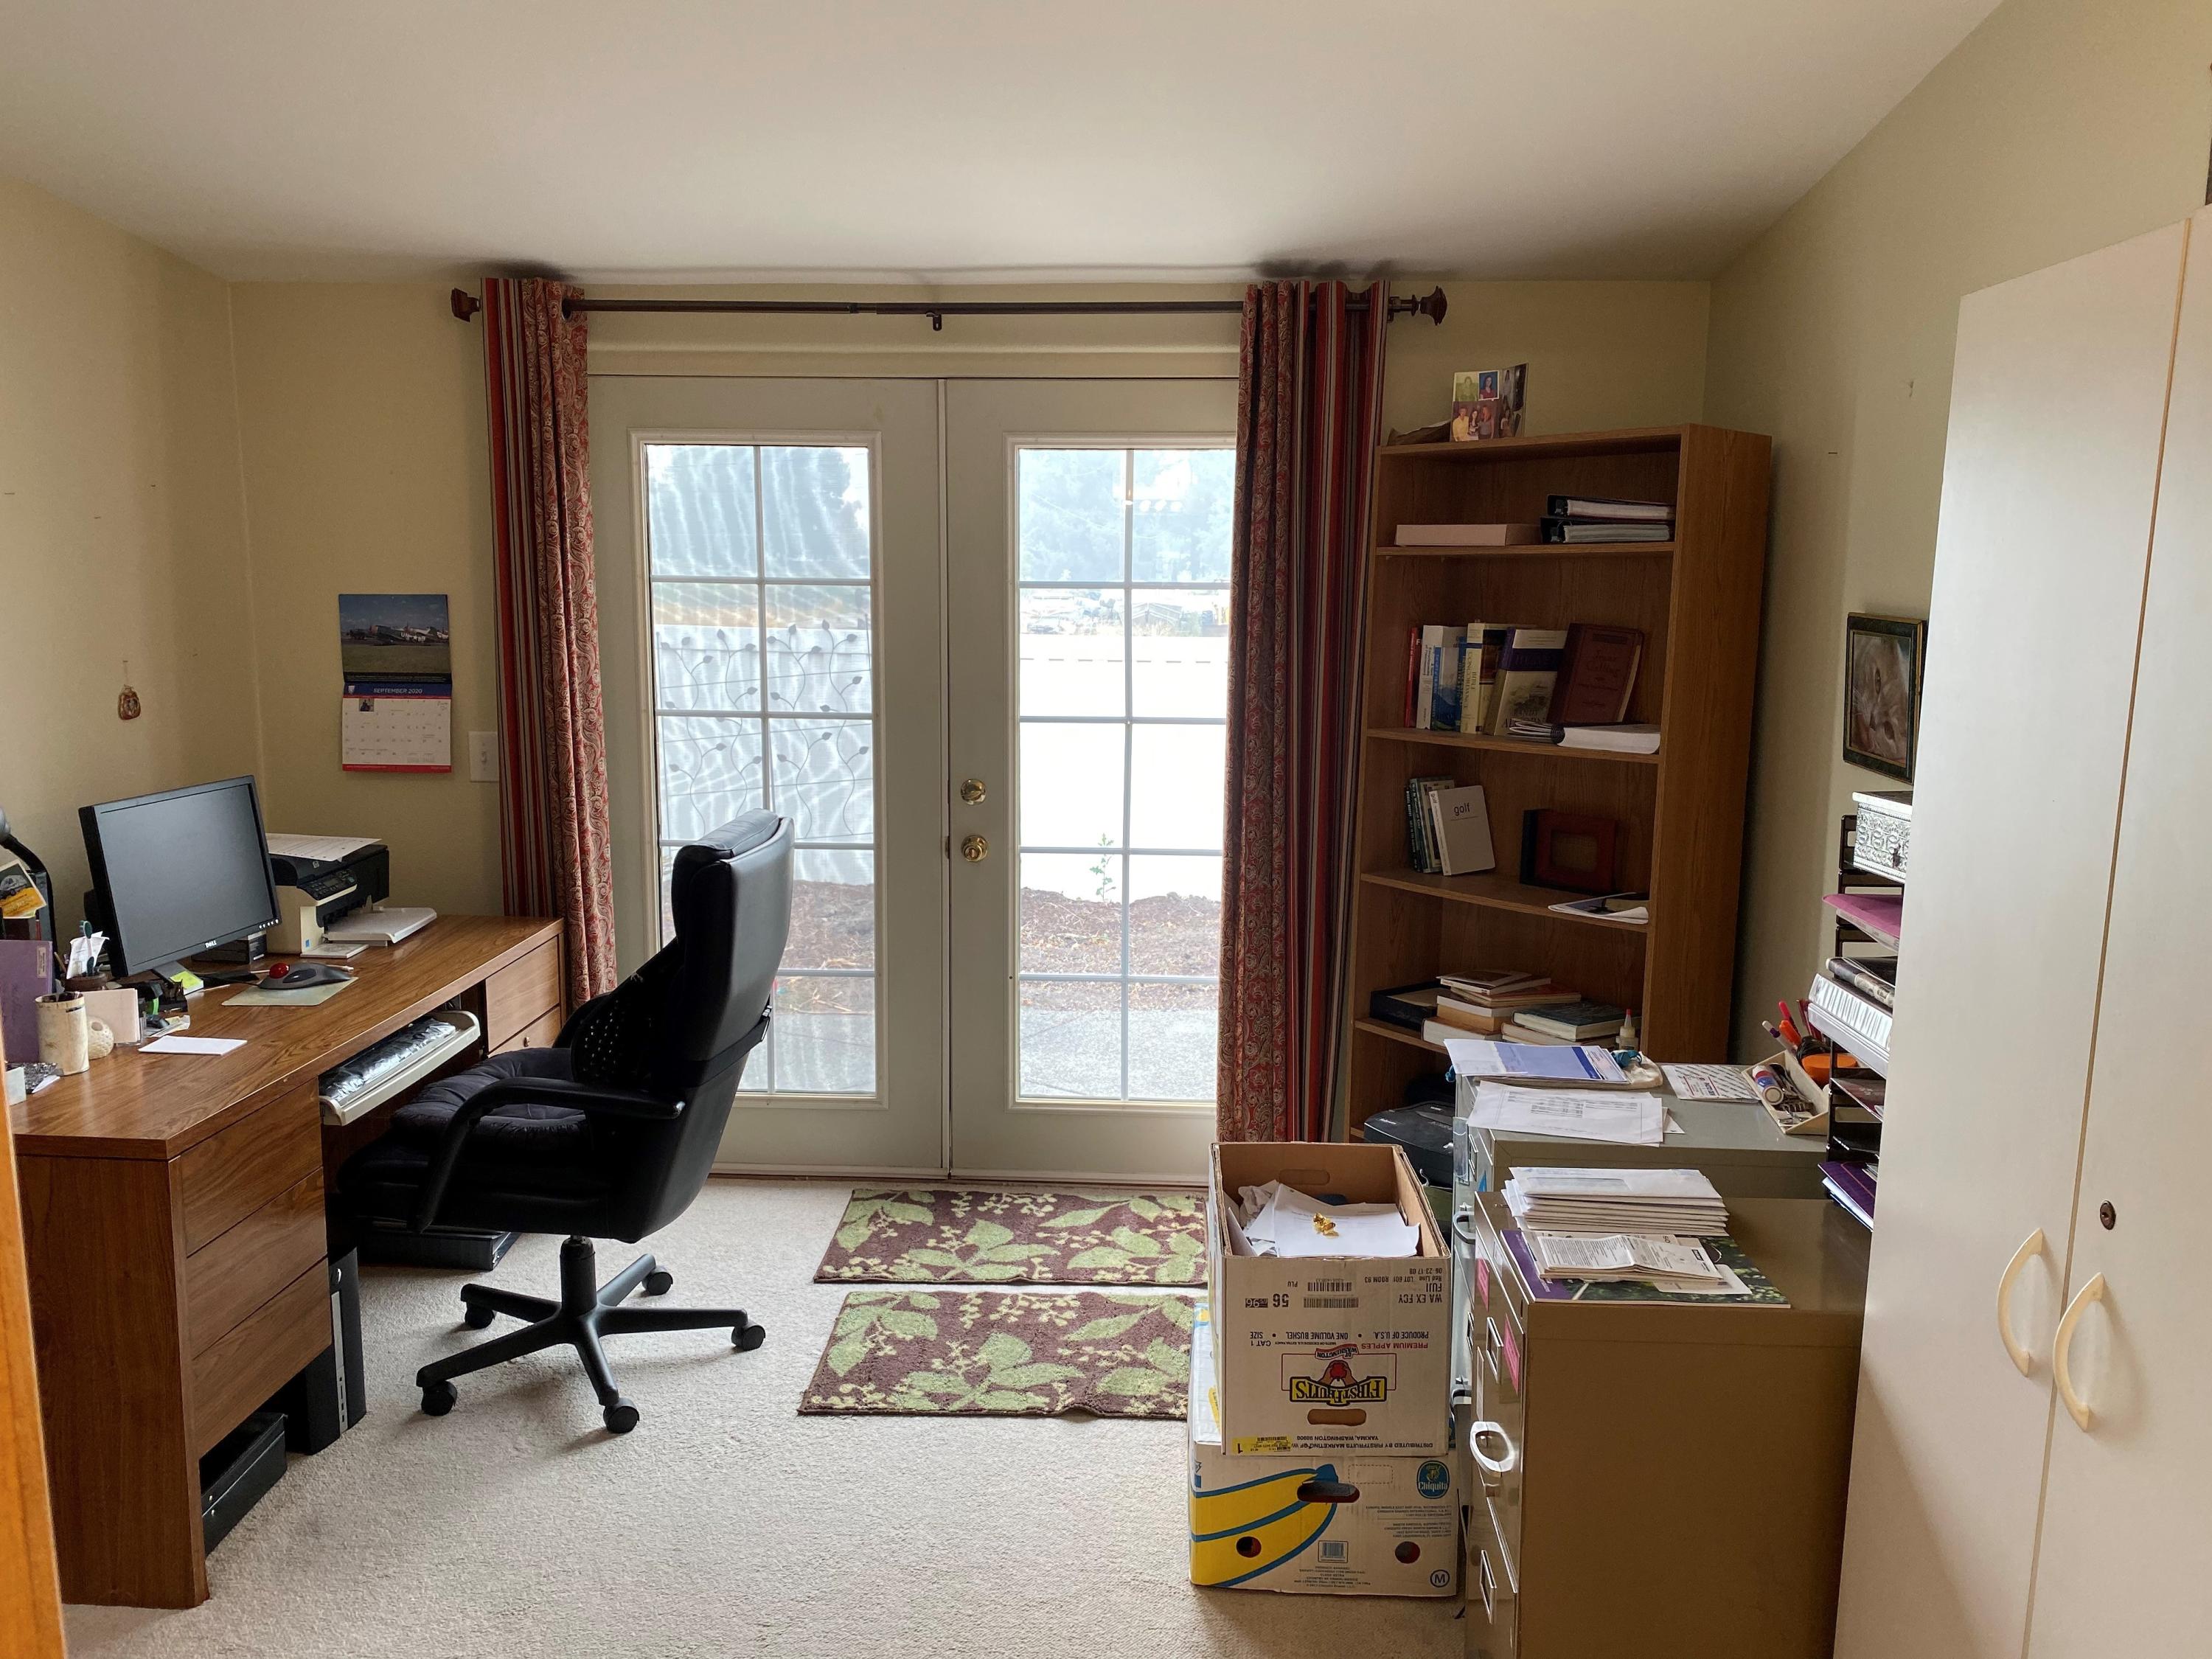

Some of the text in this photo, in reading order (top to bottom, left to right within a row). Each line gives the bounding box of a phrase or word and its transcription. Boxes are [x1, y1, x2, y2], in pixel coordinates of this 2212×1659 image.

[1454, 803, 1470, 816] golf
[205, 940, 217, 948] DELL
[1426, 1283, 1442, 1292] FUJI
[1273, 1293, 1289, 1308] 56
[1398, 1293, 1442, 1304] WA EX FCY
[1285, 1332, 1349, 1340] ONE VOLUME BUSHEL
[1373, 1331, 1429, 1340] PRODUCE OF U.S.A.
[1316, 1346, 1358, 1357] WASHINGTON
[1418, 1481, 1448, 1492] Chiquita
[1434, 1573, 1446, 1583] M
